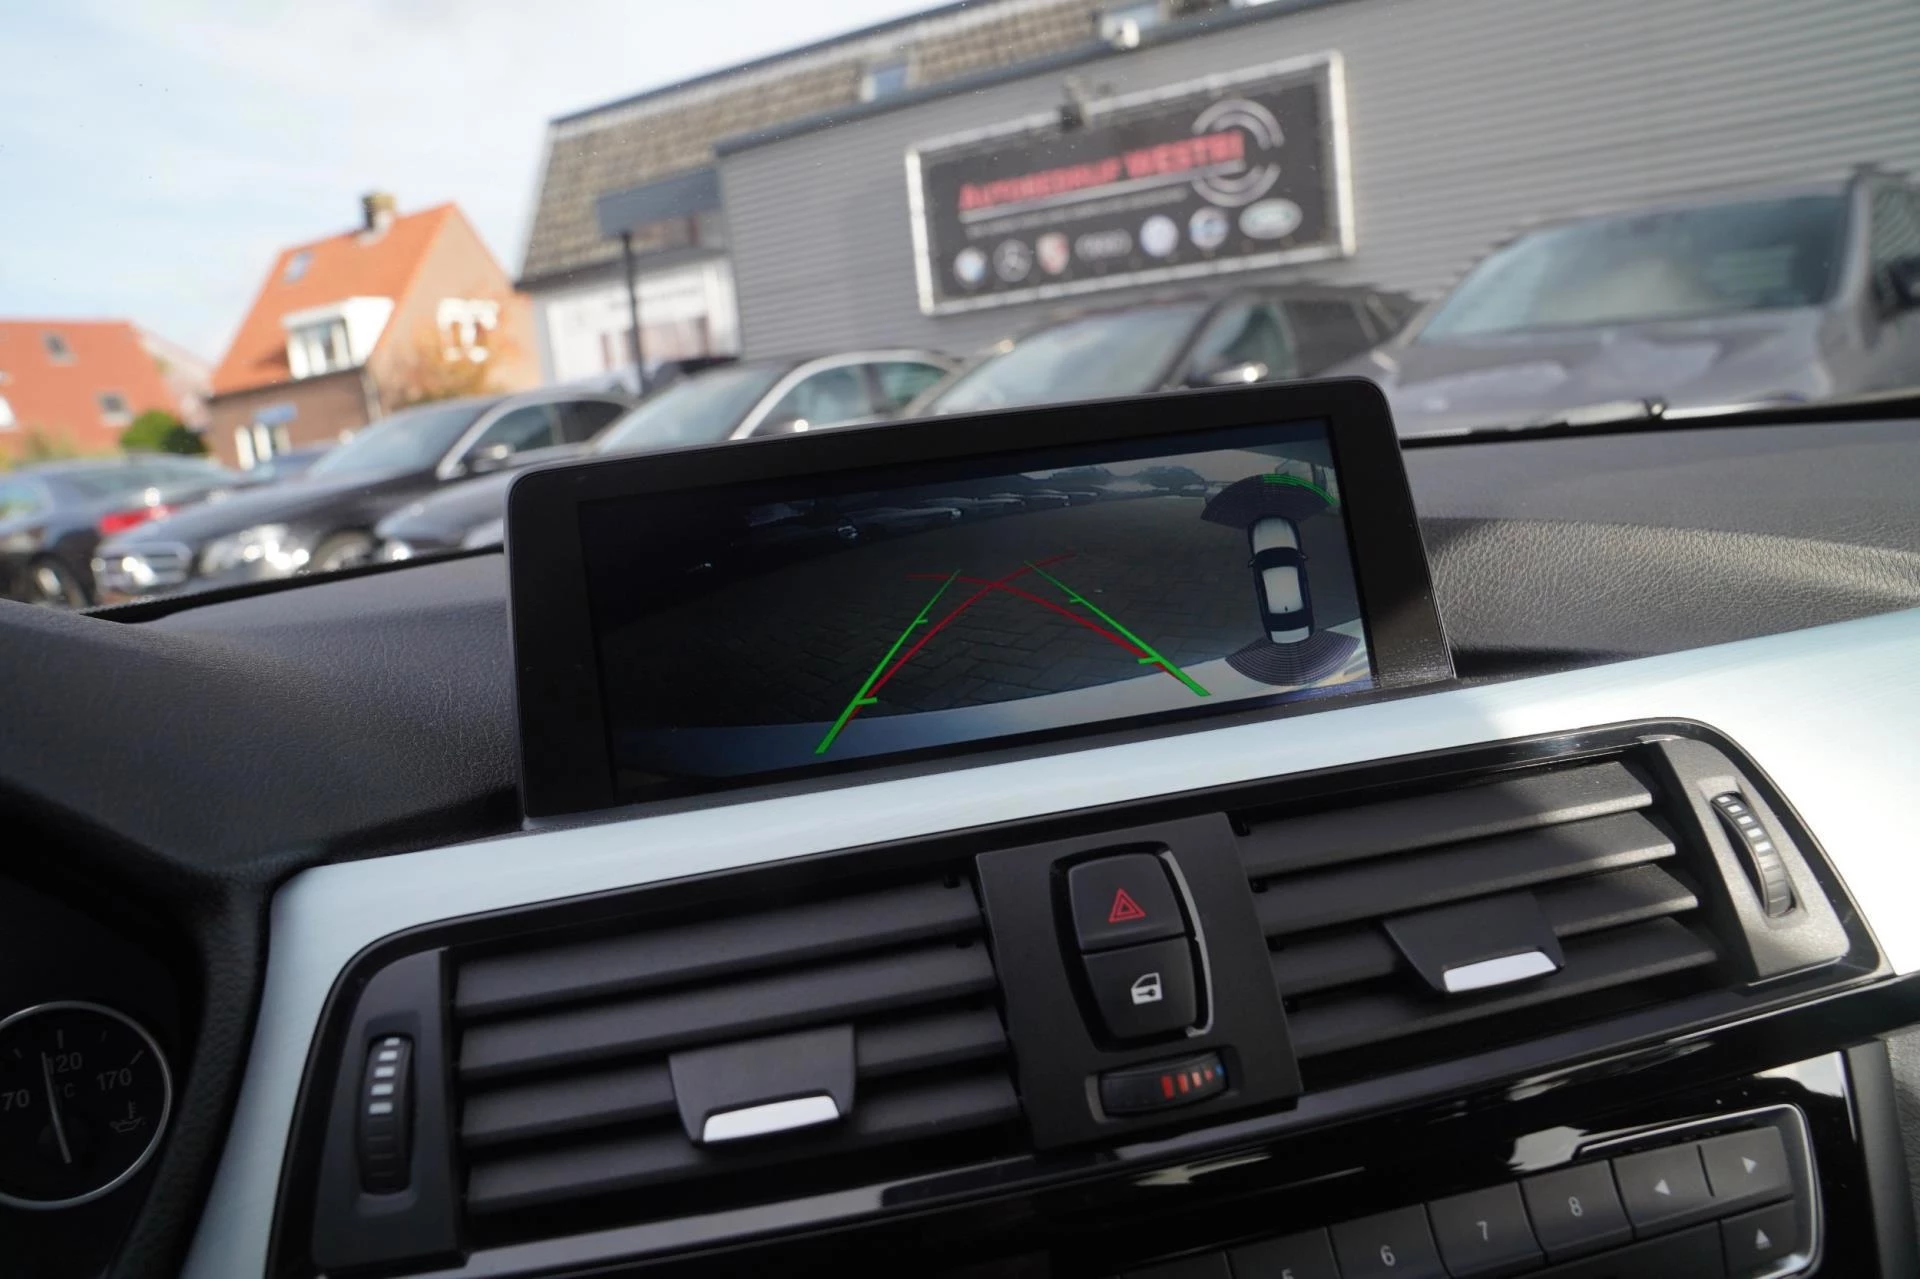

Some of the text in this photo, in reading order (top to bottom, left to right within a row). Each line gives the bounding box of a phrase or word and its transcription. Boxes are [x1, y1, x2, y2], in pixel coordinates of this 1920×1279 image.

[96, 1067, 133, 1092] 170
[1, 1088, 31, 1112] 70
[1567, 1196, 1584, 1217] 8
[1476, 1220, 1490, 1241] 7
[1379, 1245, 1396, 1267] 6
